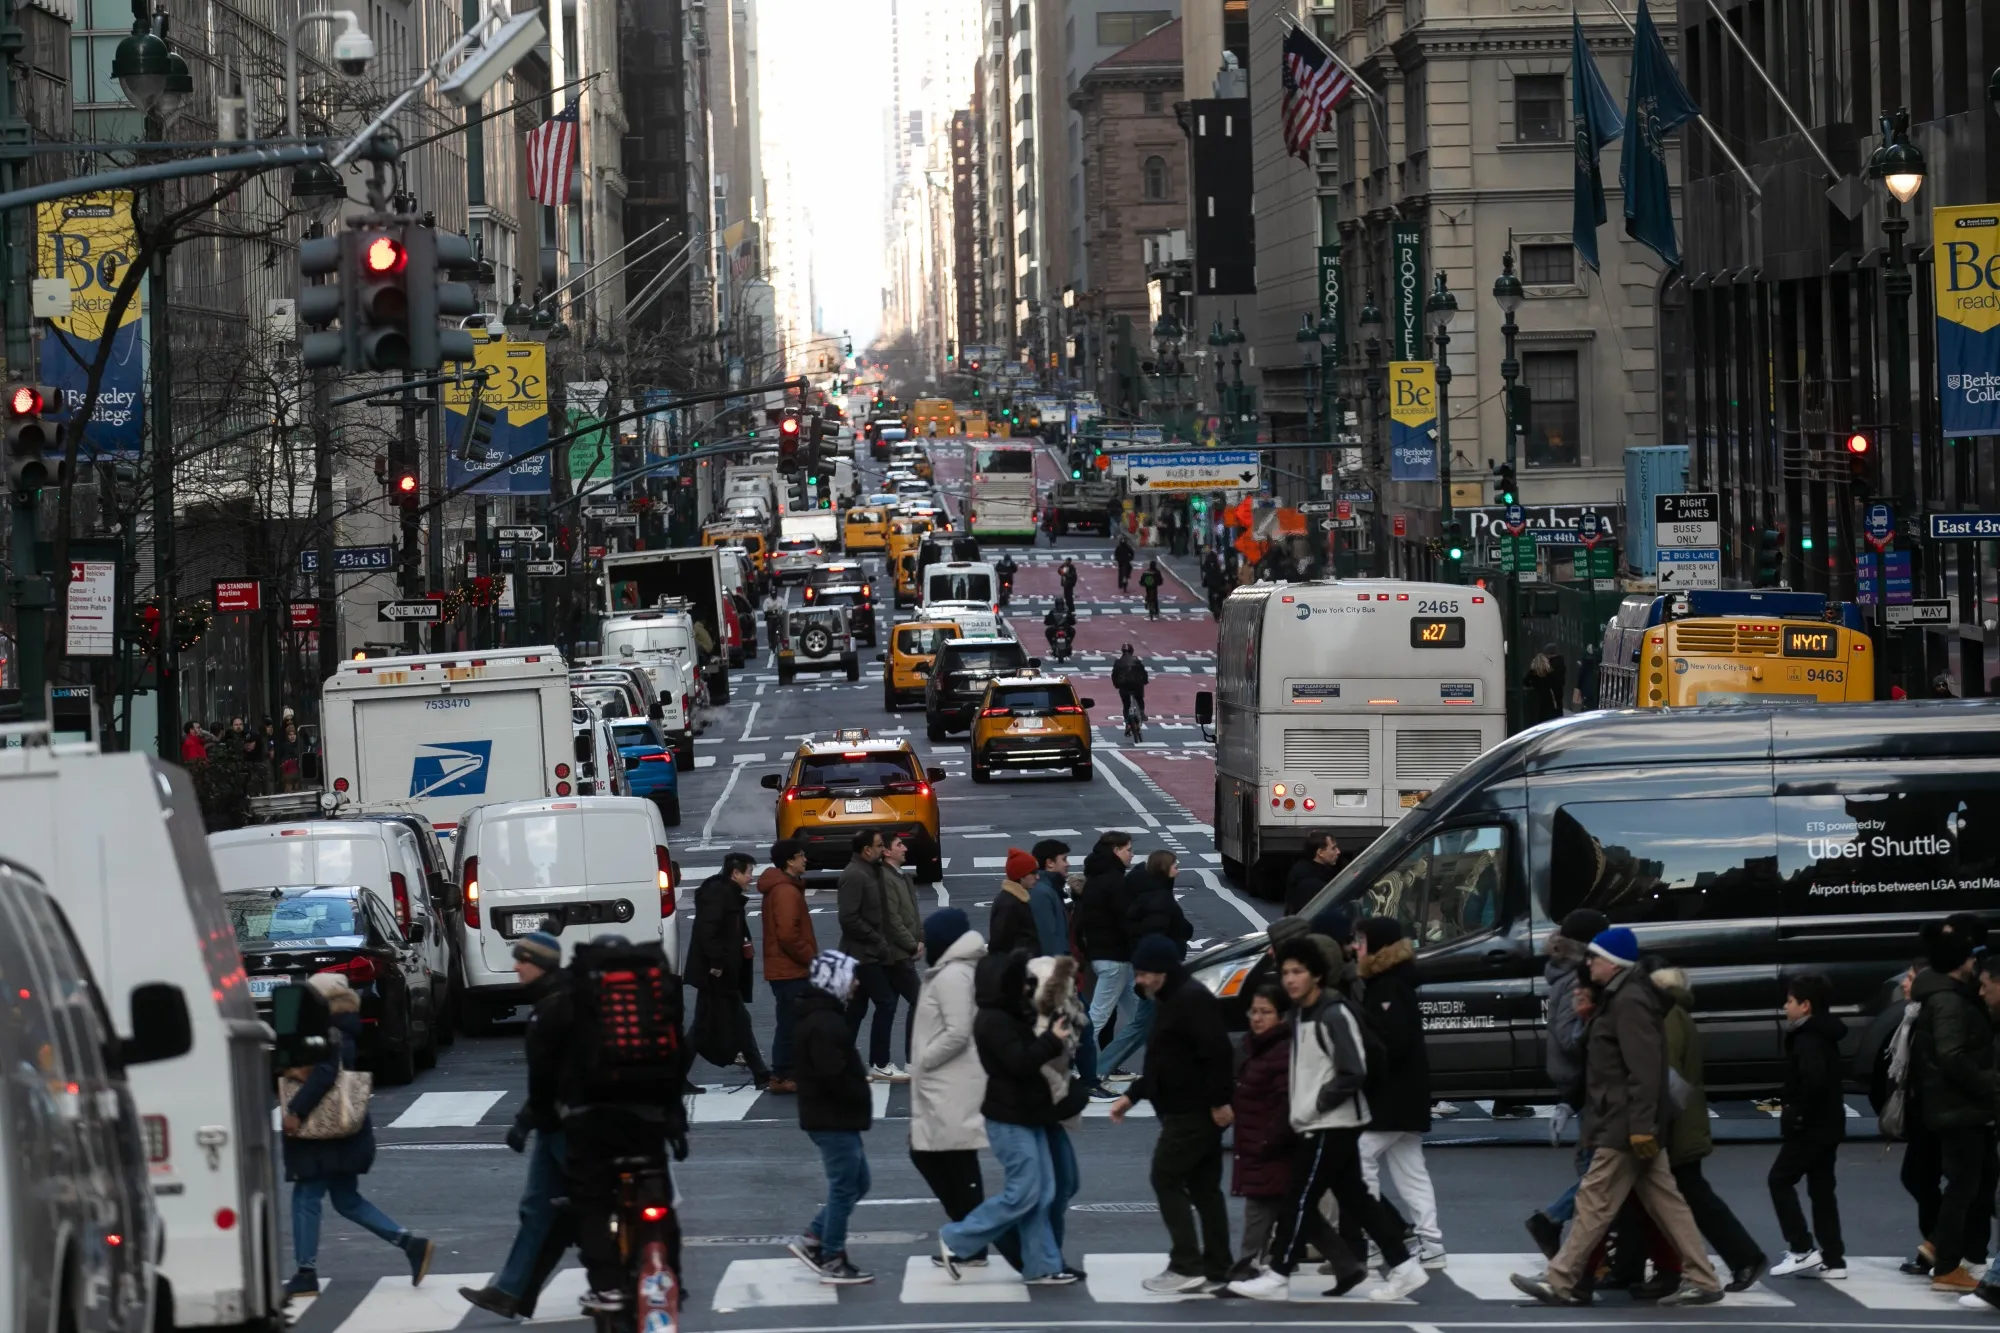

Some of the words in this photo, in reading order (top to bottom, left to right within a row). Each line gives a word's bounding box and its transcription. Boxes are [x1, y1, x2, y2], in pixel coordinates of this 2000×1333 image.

[1397, 234, 1419, 244] THE
[48, 233, 131, 292] Be
[1322, 257, 1340, 265] THE
[1957, 292, 2000, 310] ready
[1962, 372, 2000, 390] Berke
[67, 387, 136, 409] Bekeley
[1394, 379, 1432, 406] Be
[1966, 389, 2000, 404] Colle
[508, 401, 542, 412] cused
[1403, 447, 1433, 457] Berkeley
[1404, 455, 1431, 465] College
[1664, 498, 1673, 511] 2
[1680, 499, 1707, 508] RIGHT
[1678, 509, 1710, 518] LANES
[1673, 525, 1702, 533] BUSES
[1938, 519, 1971, 533] East
[1554, 531, 1576, 542] 44th
[1677, 535, 1699, 544] ONLY
[340, 553, 368, 566] 43rd
[372, 552, 386, 564] St
[1858, 555, 1868, 564] M1
[1858, 568, 1869, 577] M1
[1860, 582, 1870, 590] M2
[1859, 594, 1870, 603] M2
[389, 606, 408, 615] ONE
[413, 606, 432, 615] WAY
[1346, 606, 1360, 614] City
[1418, 600, 1459, 613] 2465
[1921, 607, 1943, 617] WAY
[1423, 623, 1447, 640] x27
[1793, 634, 1827, 650] NYCT
[1723, 664, 1737, 672] City
[1807, 668, 1844, 683] 9463
[53, 688, 89, 697] LinkNYC
[425, 698, 471, 710] 7533470
[1807, 822, 1826, 832] ETS
[1827, 820, 1872, 833] powered
[1873, 820, 1886, 831] by
[1807, 839, 1866, 860] Uber
[1871, 835, 1951, 857] Shuttle
[1809, 882, 1850, 897] Airport
[1851, 881, 1876, 895] trips
[1878, 880, 1929, 892] between
[1931, 879, 1956, 890] LGA
[1959, 878, 1980, 889] and
[1418, 1002, 1452, 1014] PERATED
[1453, 1001, 1466, 1013] BY:
[1429, 1017, 1461, 1029] AIRPORT
[1462, 1015, 1495, 1028] SHUTTLE
